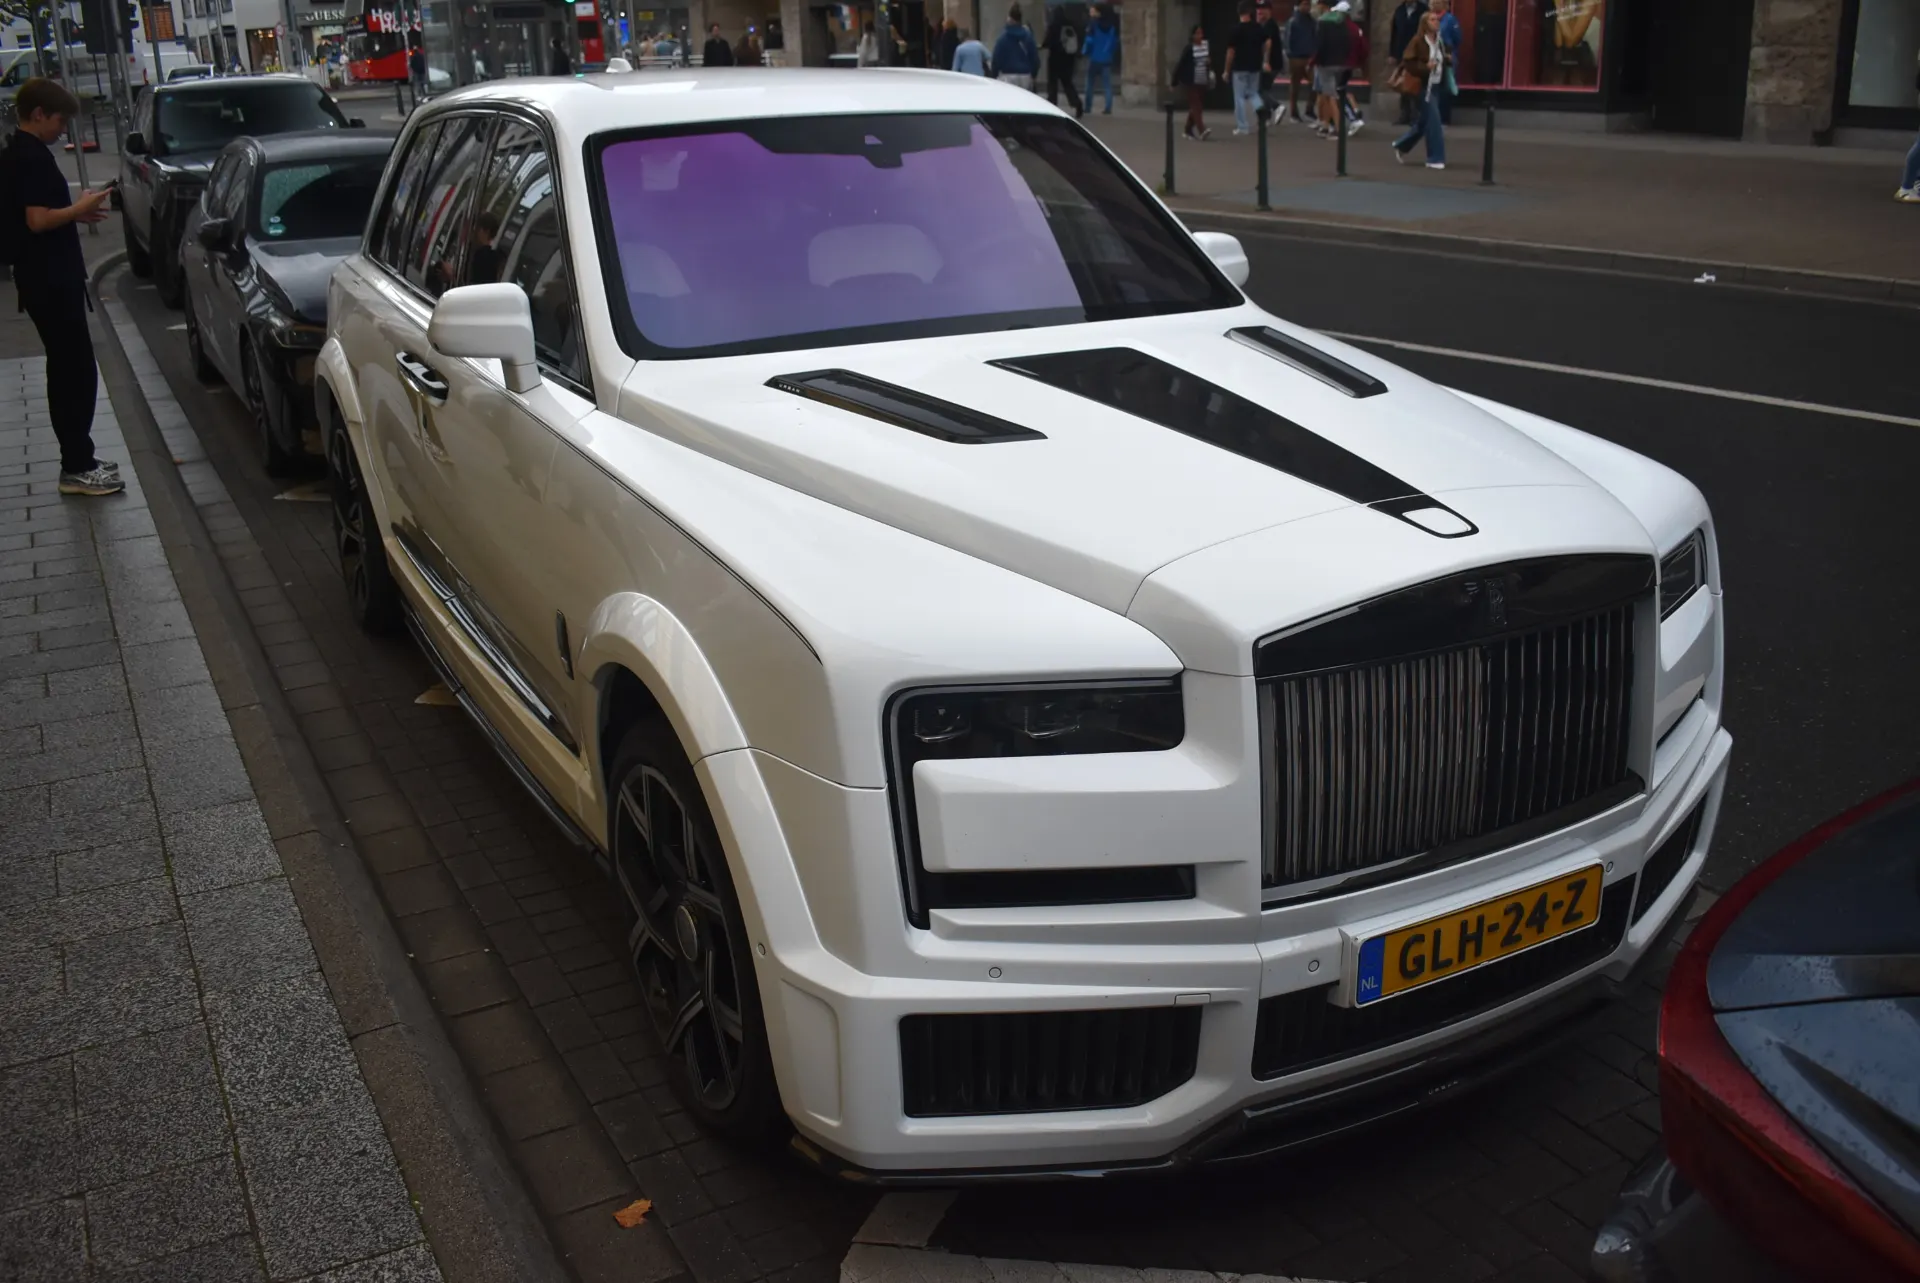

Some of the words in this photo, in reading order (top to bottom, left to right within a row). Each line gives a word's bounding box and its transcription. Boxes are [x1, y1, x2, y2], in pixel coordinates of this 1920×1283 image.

[305, 9, 345, 21] GUESS
[1399, 878, 1587, 979] GLH-24-Z
[1361, 976, 1378, 991] NL
